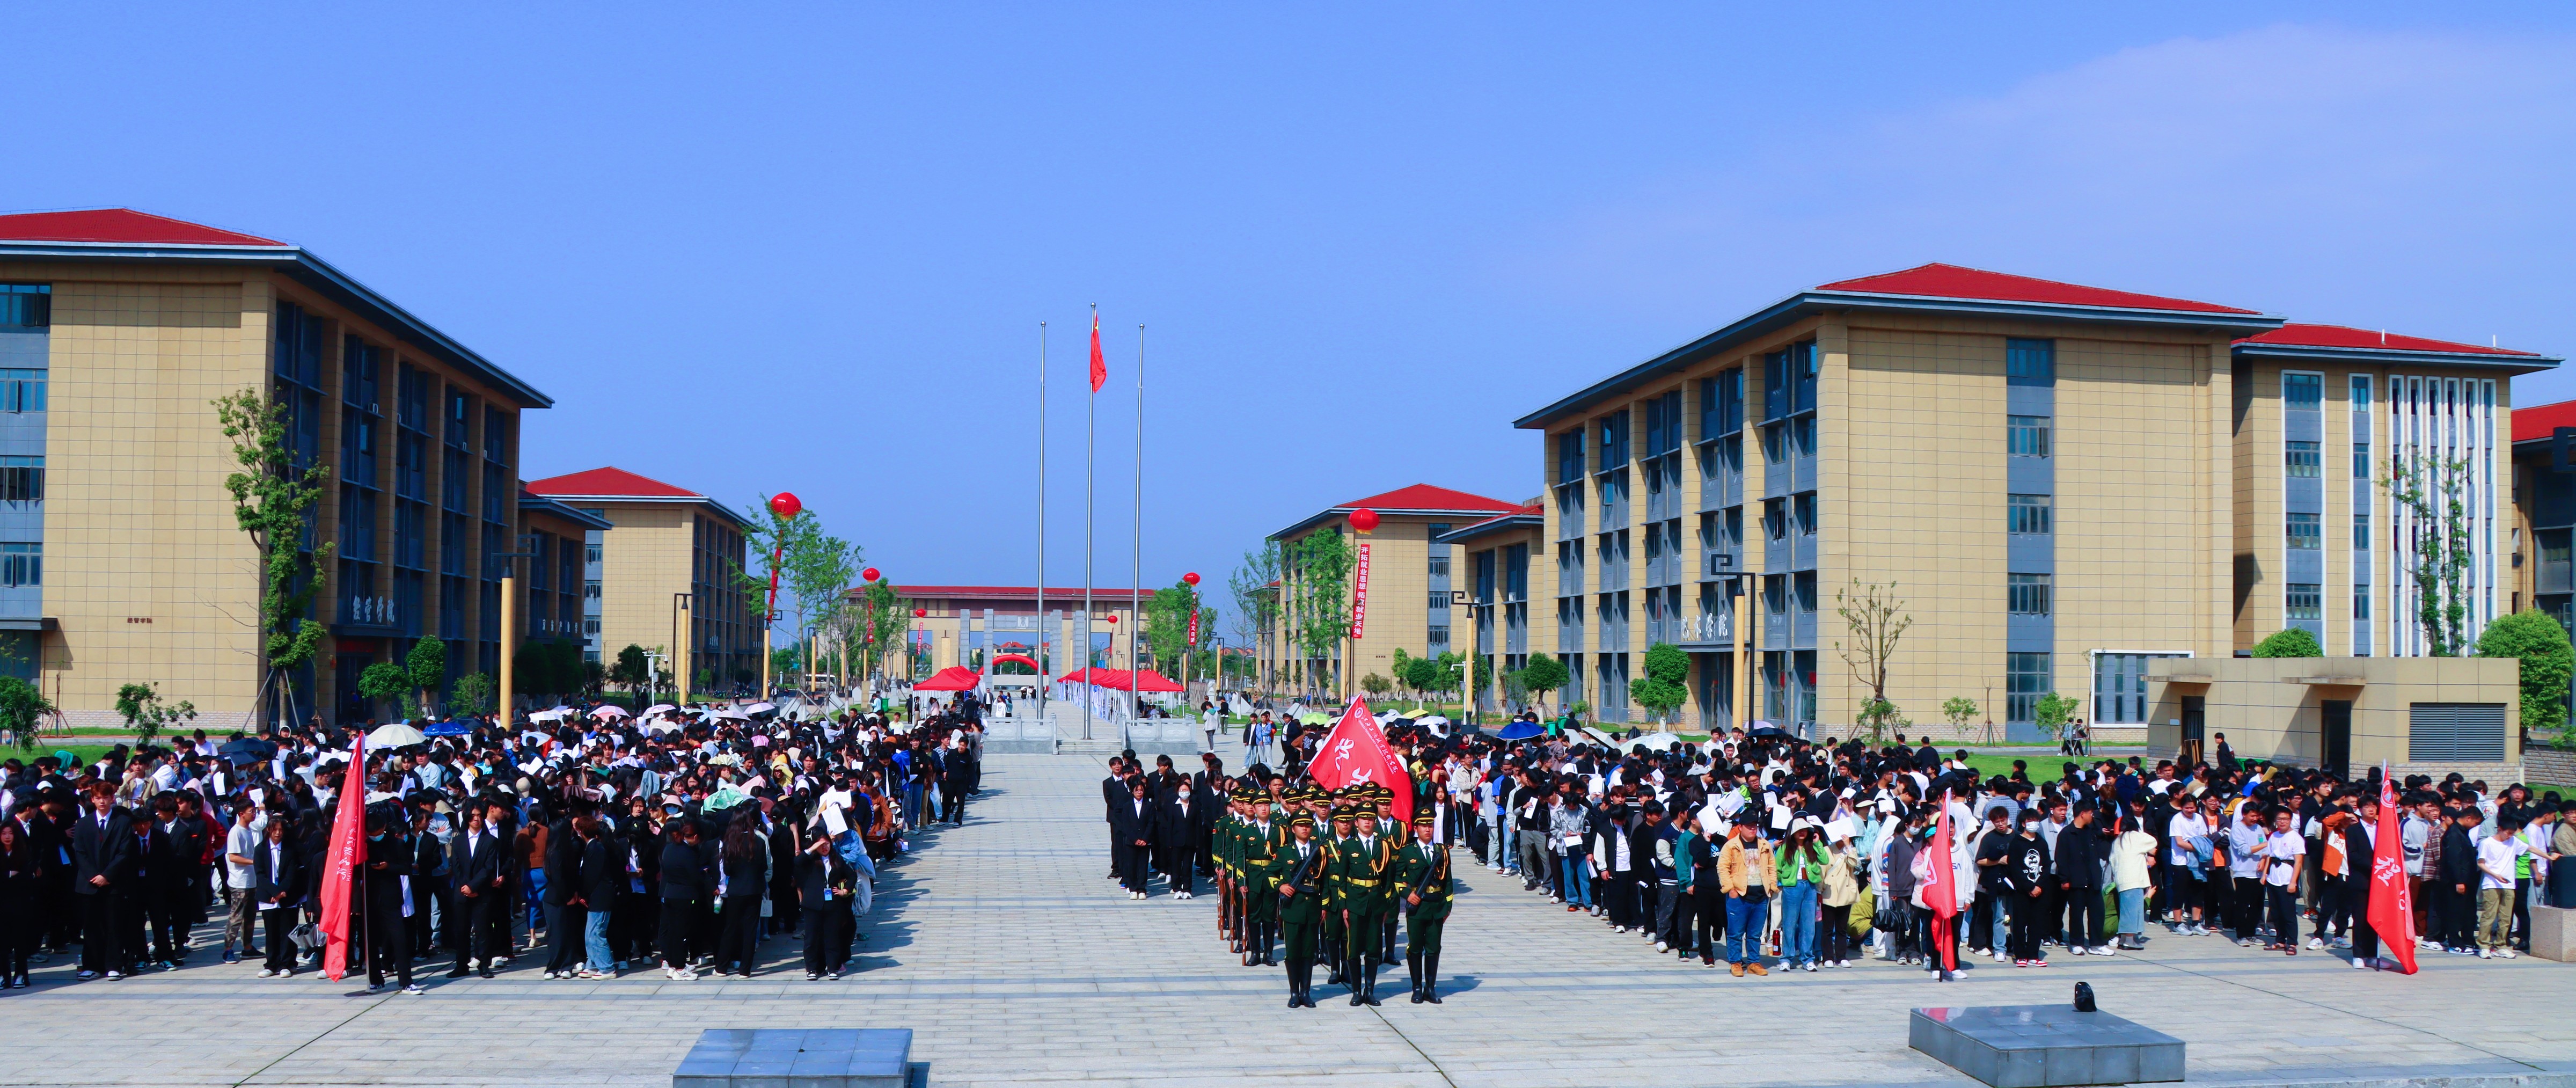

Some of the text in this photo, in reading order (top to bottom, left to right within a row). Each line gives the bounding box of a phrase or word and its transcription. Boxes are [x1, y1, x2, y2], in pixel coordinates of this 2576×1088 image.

[1358, 546, 1368, 590] 开拓就业思想
